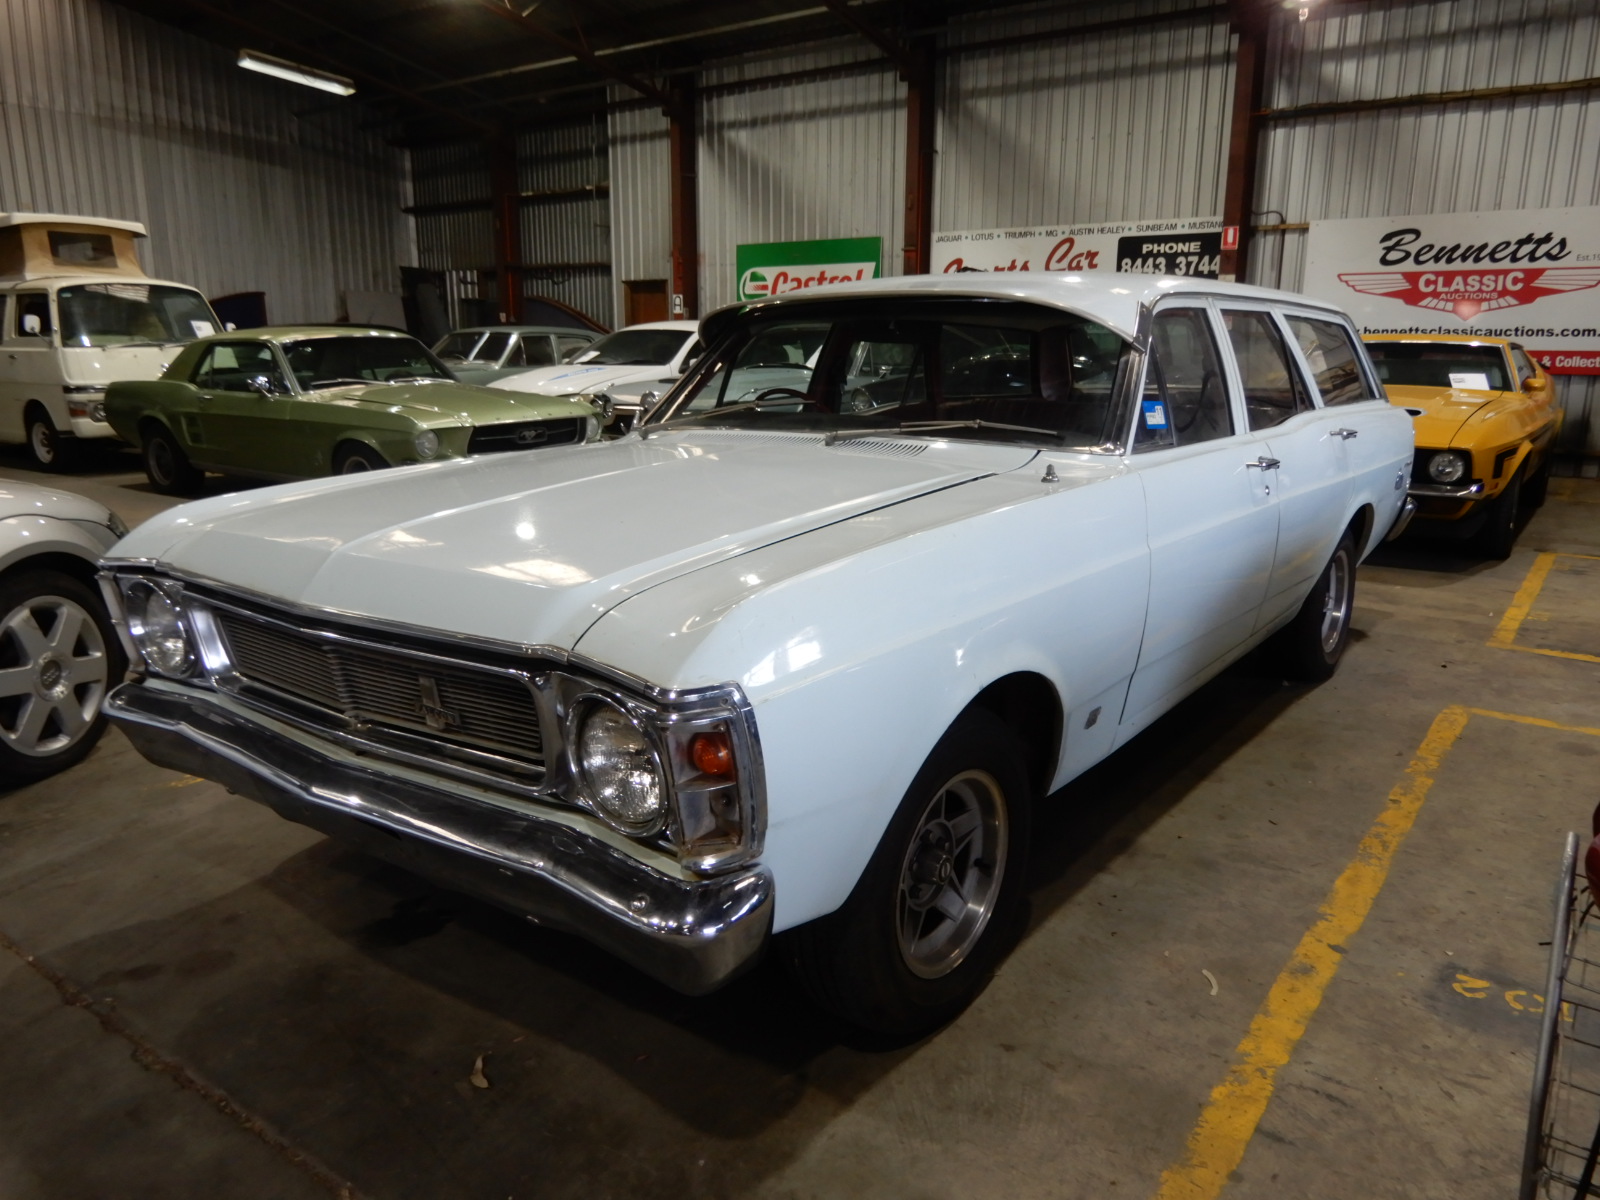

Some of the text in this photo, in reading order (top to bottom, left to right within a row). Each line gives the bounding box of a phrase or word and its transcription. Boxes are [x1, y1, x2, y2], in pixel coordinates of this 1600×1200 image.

[936, 235, 962, 243] JAGUAR
[971, 233, 994, 241] LOTUS
[1004, 231, 1036, 239] TRIUMPH
[1045, 230, 1058, 238] MG
[1068, 228, 1095, 236] AUSTIN
[1097, 226, 1126, 234] HEALEY
[1136, 223, 1178, 232] SUNBEAM
[1045, 237, 1100, 271] Car
[1142, 242, 1202, 254] PHONE
[1379, 228, 1571, 266] Bennetts
[1121, 255, 1221, 276] 8443 3744
[1418, 271, 1525, 293] CLASSIC
[673, 295, 682, 311] A
[1439, 292, 1498, 300] AUCTIONS
